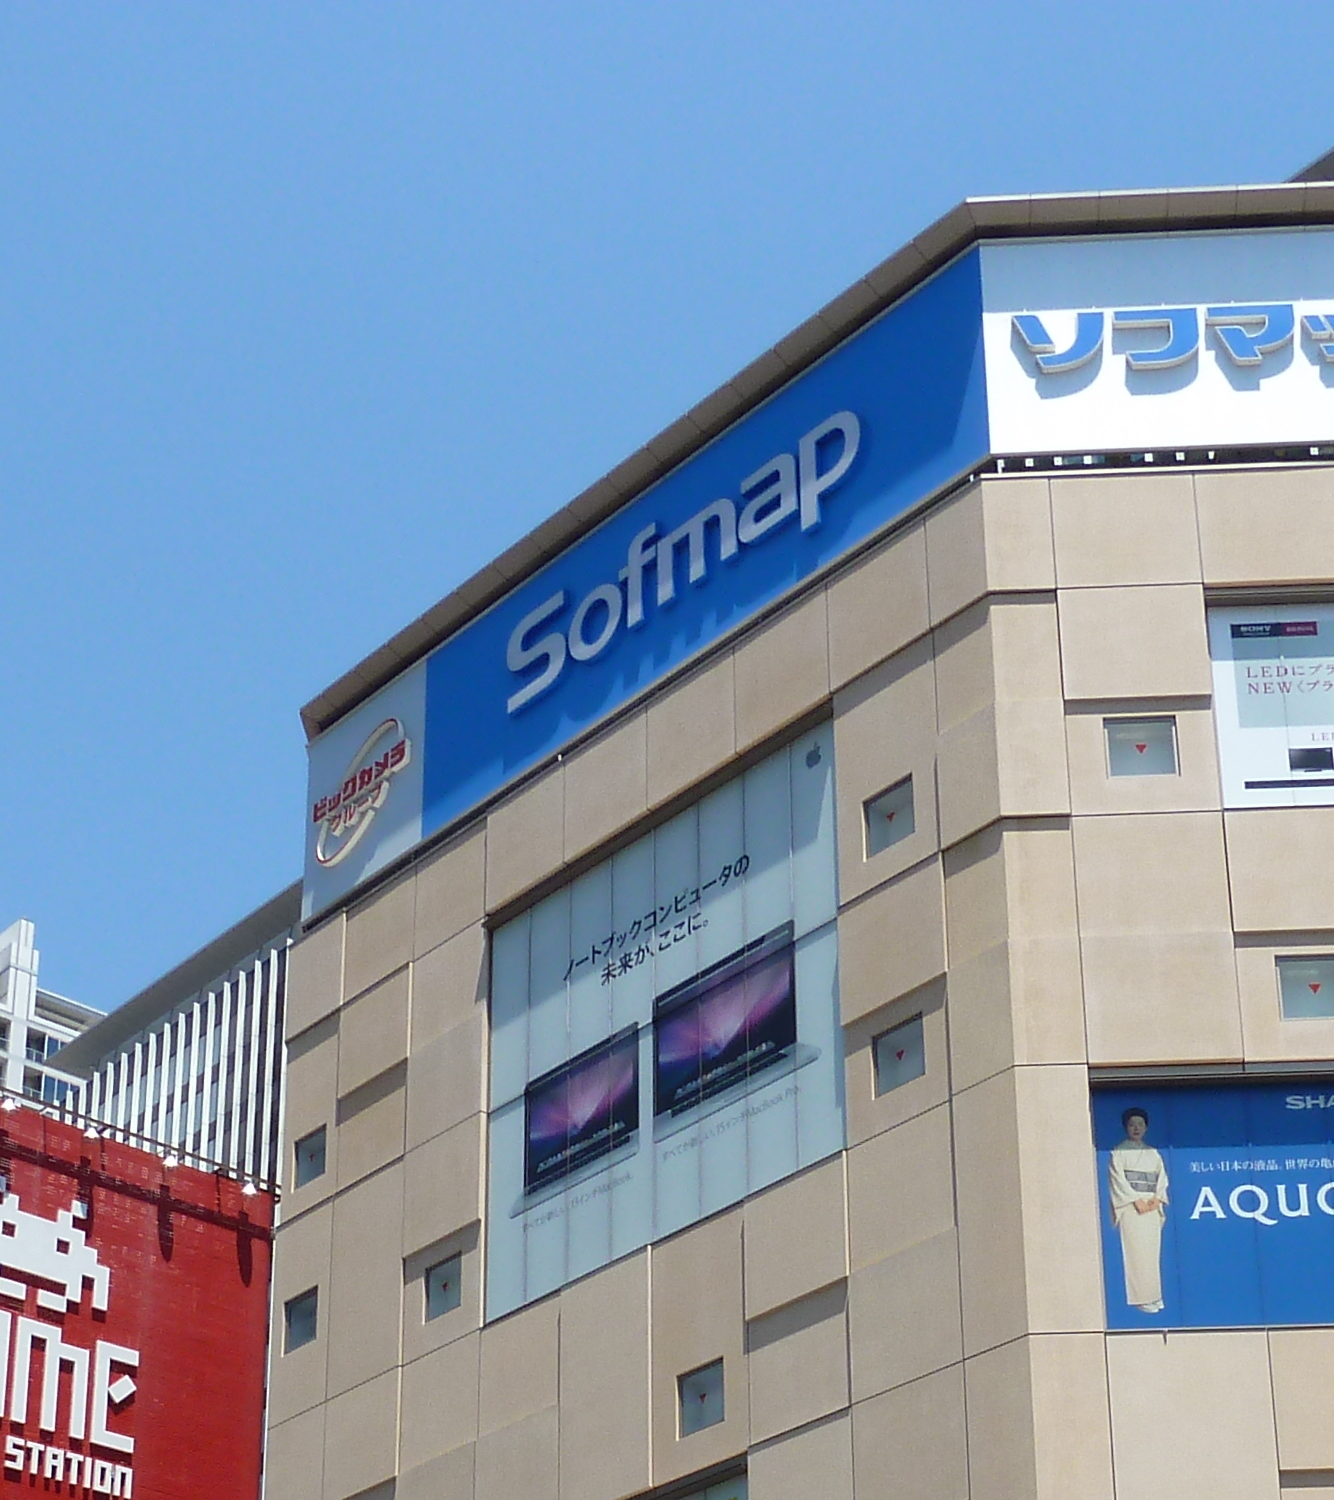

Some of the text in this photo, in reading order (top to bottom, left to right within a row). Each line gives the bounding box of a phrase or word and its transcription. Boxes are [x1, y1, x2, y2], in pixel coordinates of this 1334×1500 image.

[506, 409, 861, 714] Sofmap
[313, 738, 411, 822] ビックカメラ
[562, 853, 750, 981] ノートブックコンピュータの
[600, 914, 709, 987] 未来が、ここに。
[3, 1435, 134, 1499] STATION
